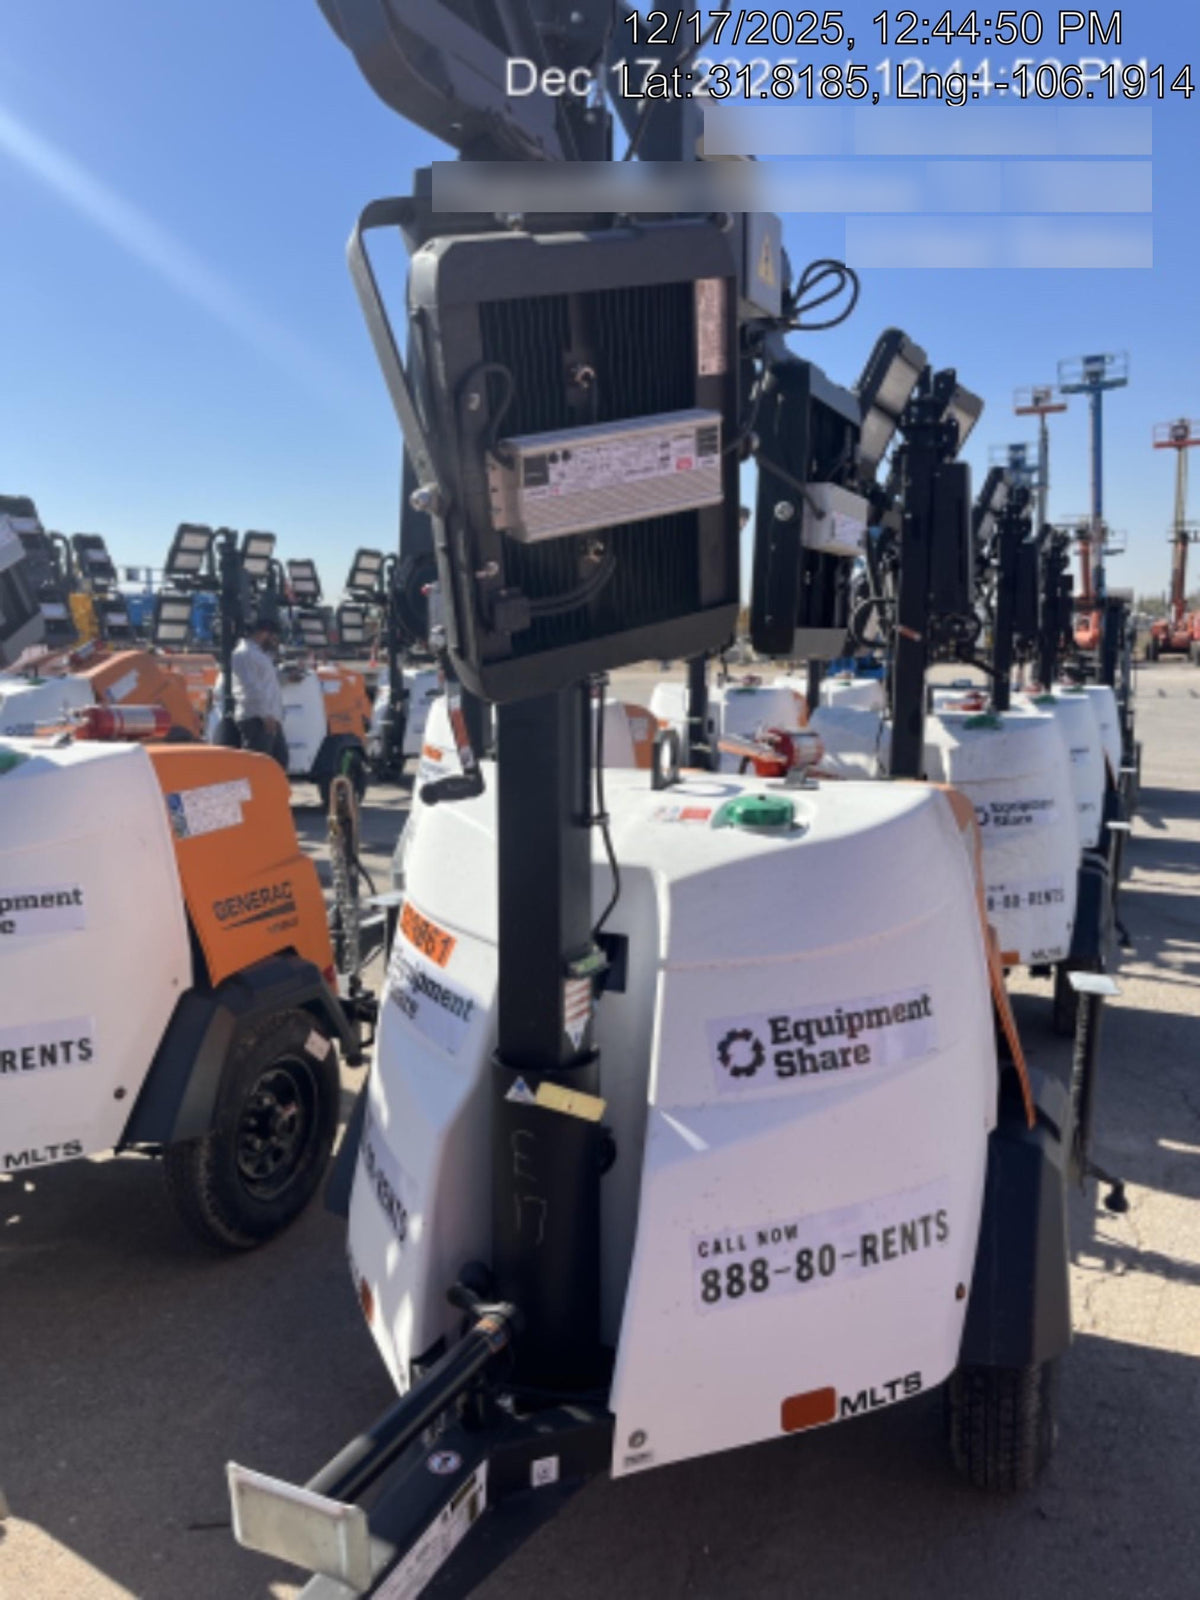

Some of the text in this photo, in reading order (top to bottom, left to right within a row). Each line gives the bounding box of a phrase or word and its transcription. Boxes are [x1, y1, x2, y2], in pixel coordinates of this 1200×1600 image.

[213, 880, 293, 922] GENERAC
[768, 994, 932, 1046] Equipment
[774, 1043, 871, 1078] Share
[4, 1139, 83, 1169] MLTS
[698, 1224, 798, 1258] CALL NOW
[701, 1210, 949, 1303] 888-80-RENTS
[840, 1371, 922, 1416] MLTS
